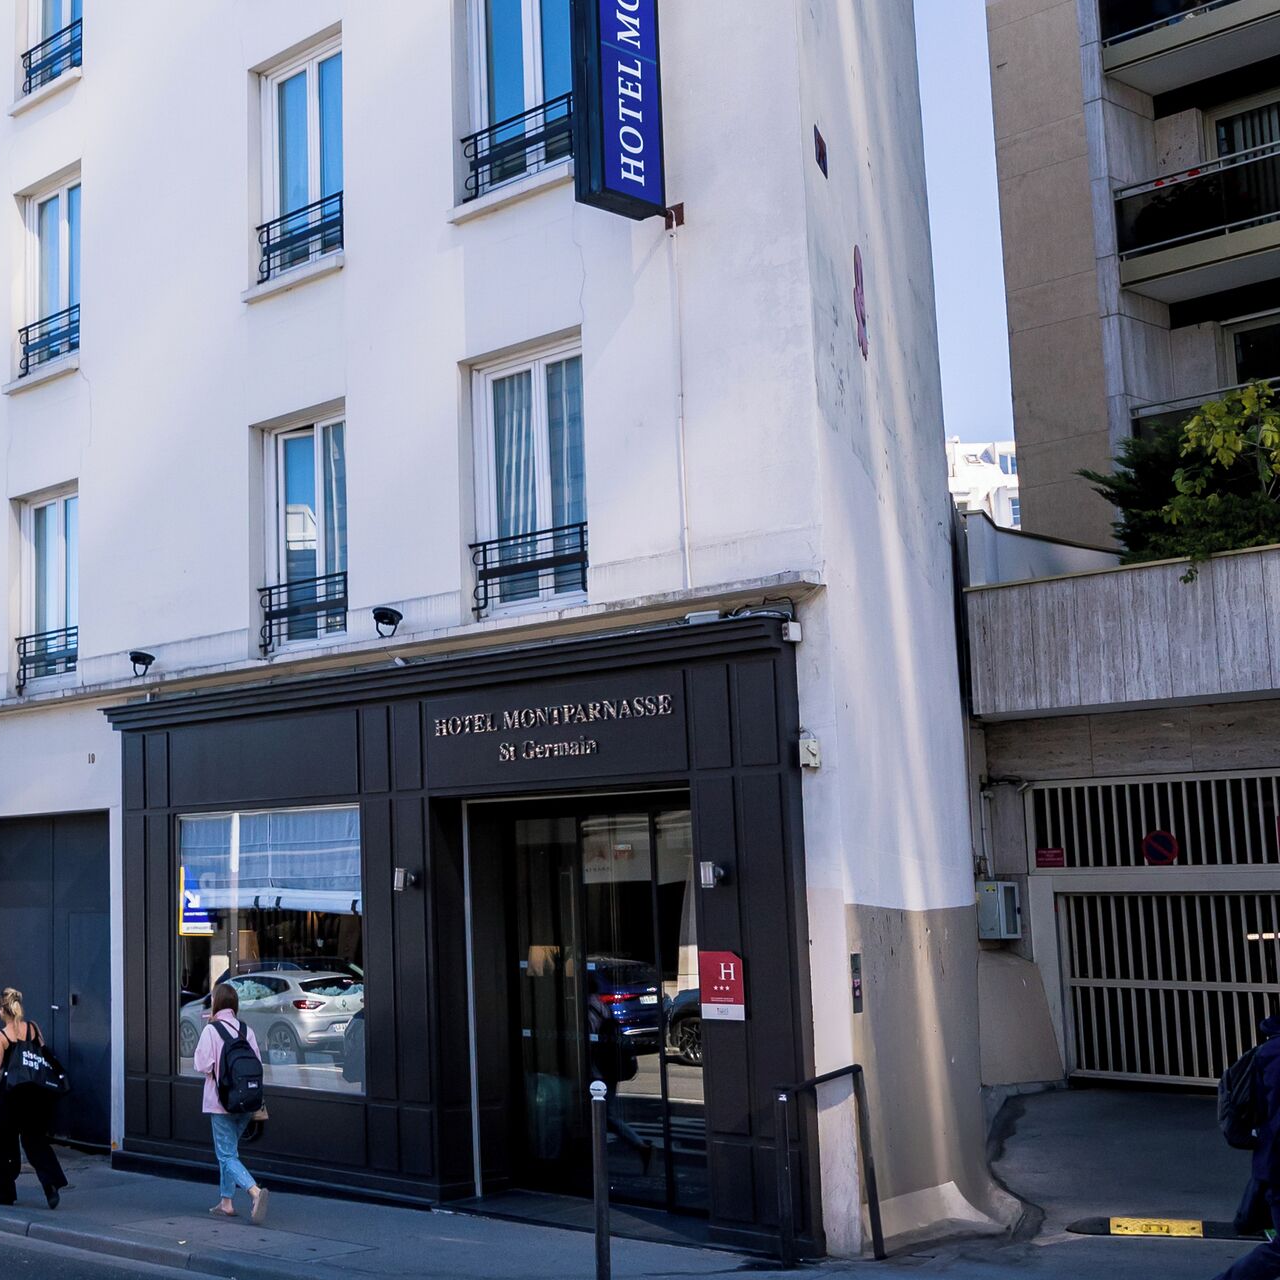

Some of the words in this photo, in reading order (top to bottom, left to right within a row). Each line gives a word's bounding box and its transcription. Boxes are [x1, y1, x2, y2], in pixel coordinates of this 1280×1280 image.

[619, 59, 645, 187] HOTEL
[434, 713, 498, 737] HOTEL
[503, 694, 673, 730] MONTPARNASSE
[499, 742, 517, 762] St
[522, 735, 598, 760] Germain
[719, 962, 736, 981] H
